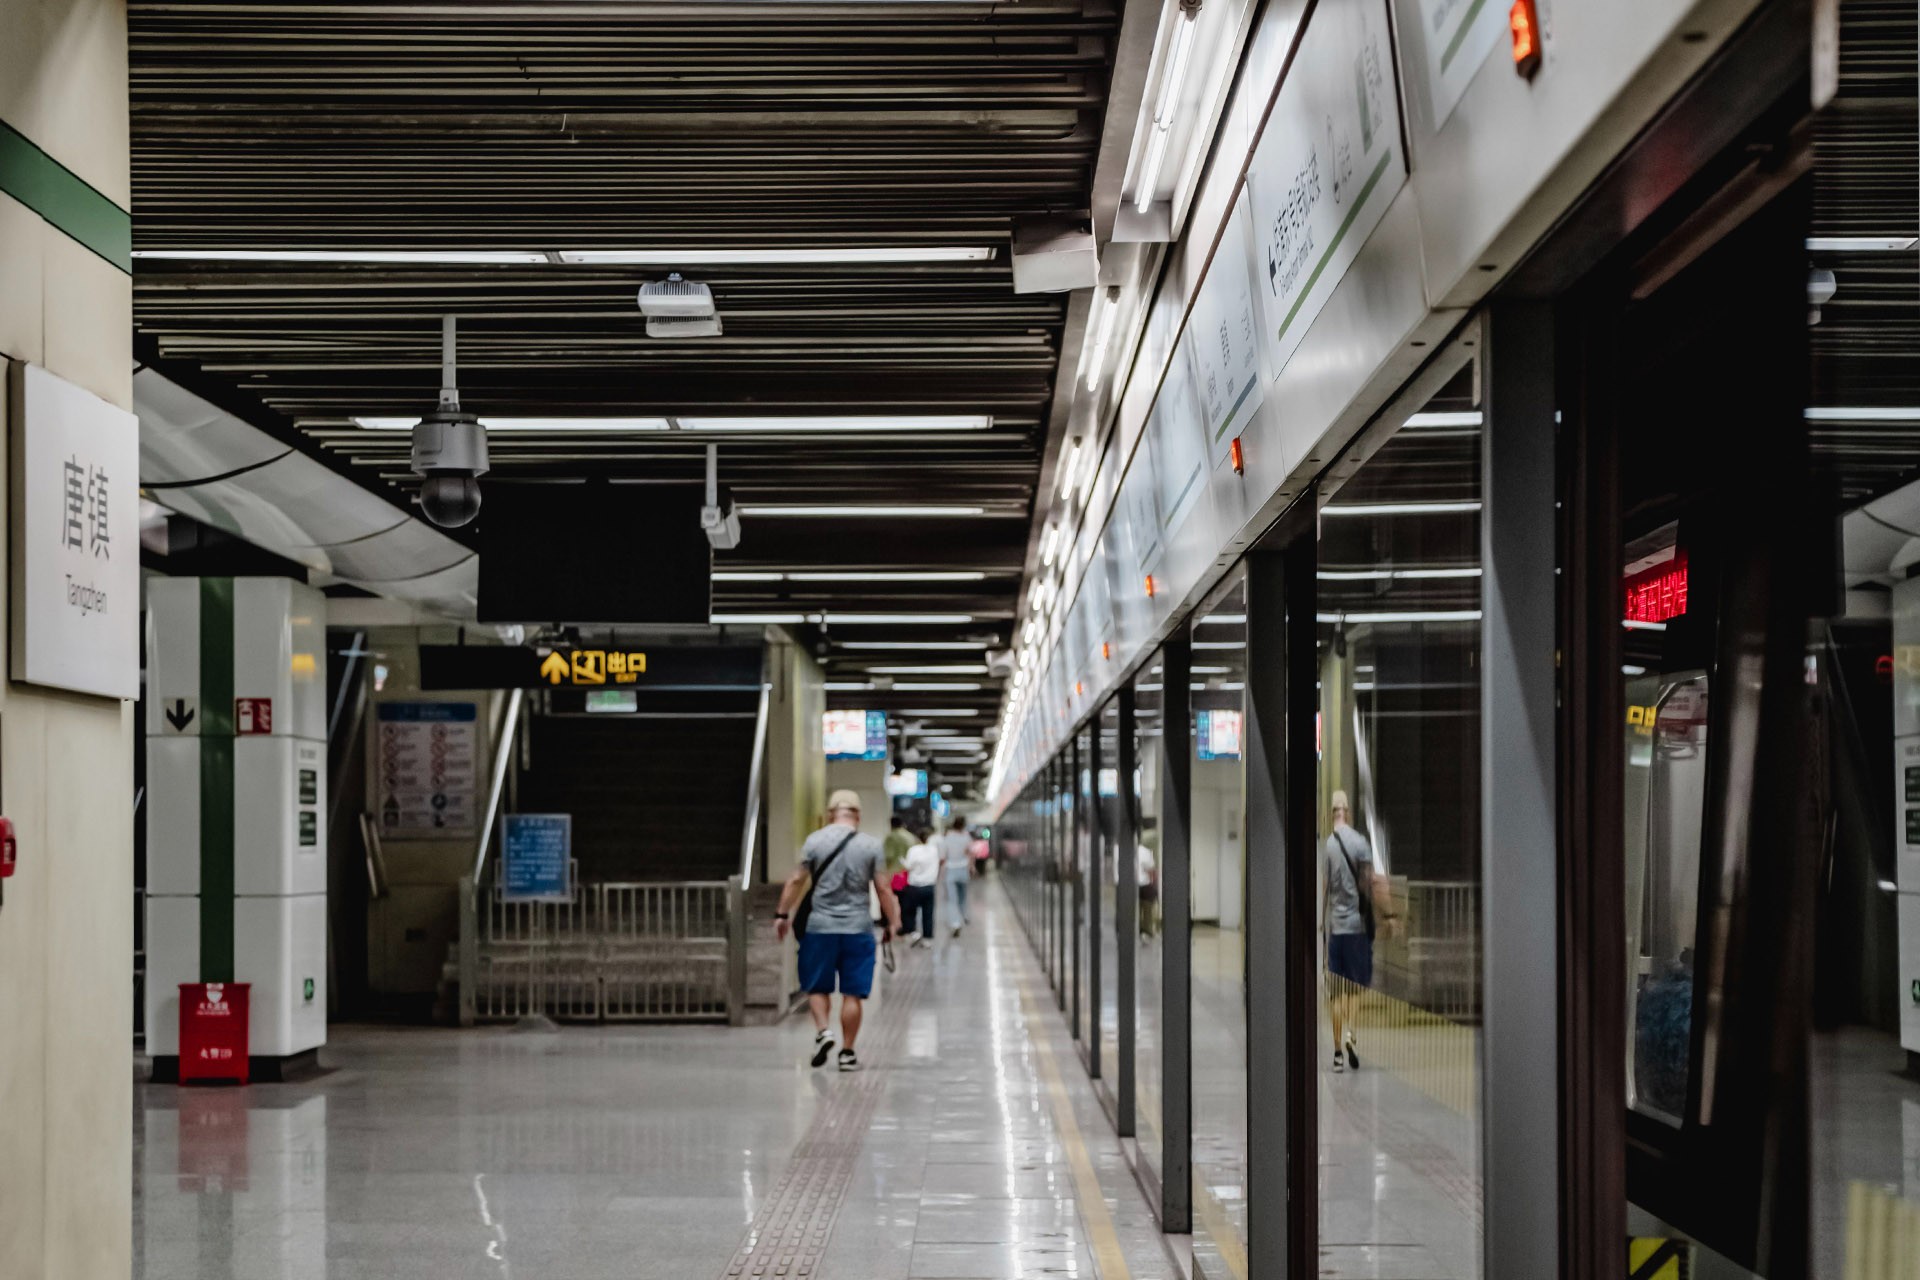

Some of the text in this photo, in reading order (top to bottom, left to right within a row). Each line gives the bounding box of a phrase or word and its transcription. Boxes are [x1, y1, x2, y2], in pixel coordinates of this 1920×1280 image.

[62, 453, 110, 560] 唐镇
[65, 573, 107, 616] Tangzhen
[607, 651, 647, 673] 出口
